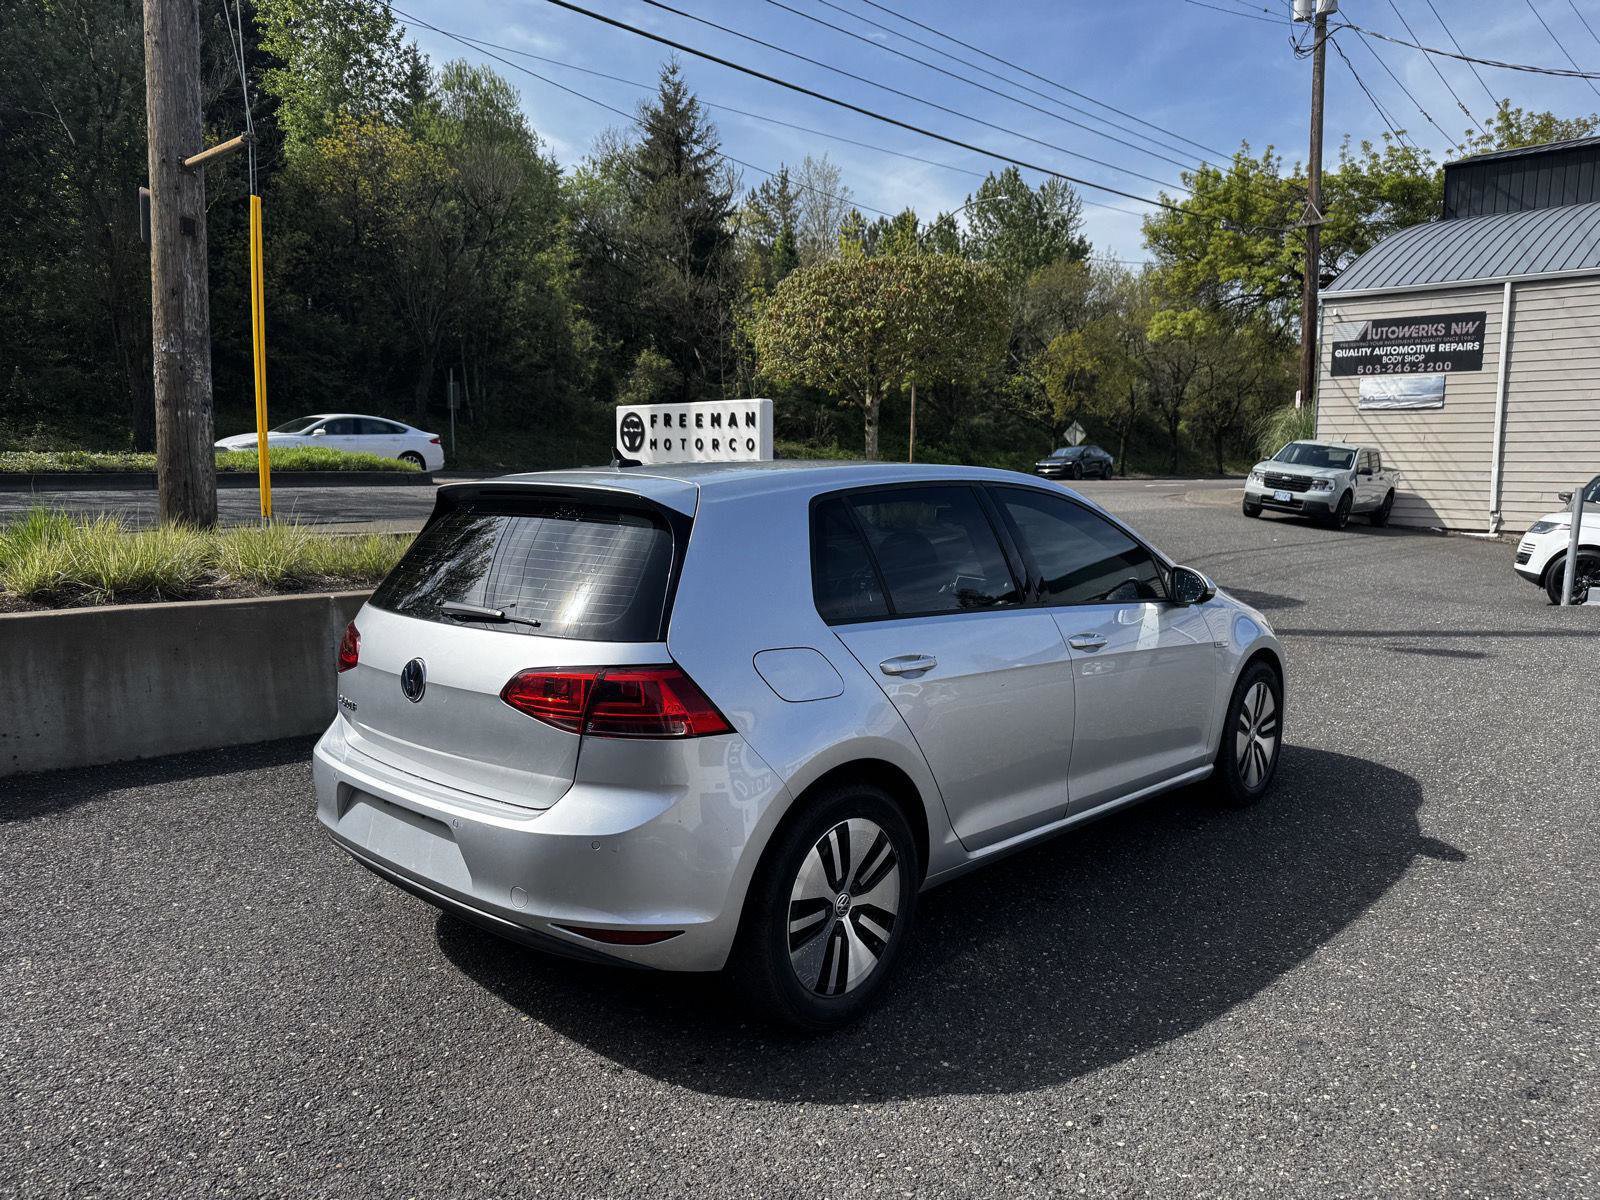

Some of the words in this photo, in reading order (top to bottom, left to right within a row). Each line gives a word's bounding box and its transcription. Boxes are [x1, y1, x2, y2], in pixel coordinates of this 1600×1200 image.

[1450, 320, 1481, 335] NW
[1335, 347, 1373, 358] QUALITY
[1373, 343, 1436, 356] AUTOMOTIVE
[1438, 341, 1480, 352] REPAIRS
[1382, 355, 1402, 364] BODY
[1404, 354, 1426, 363] SHOP
[1357, 362, 1452, 374] 503-246-2200
[650, 411, 756, 429] FREEMAN
